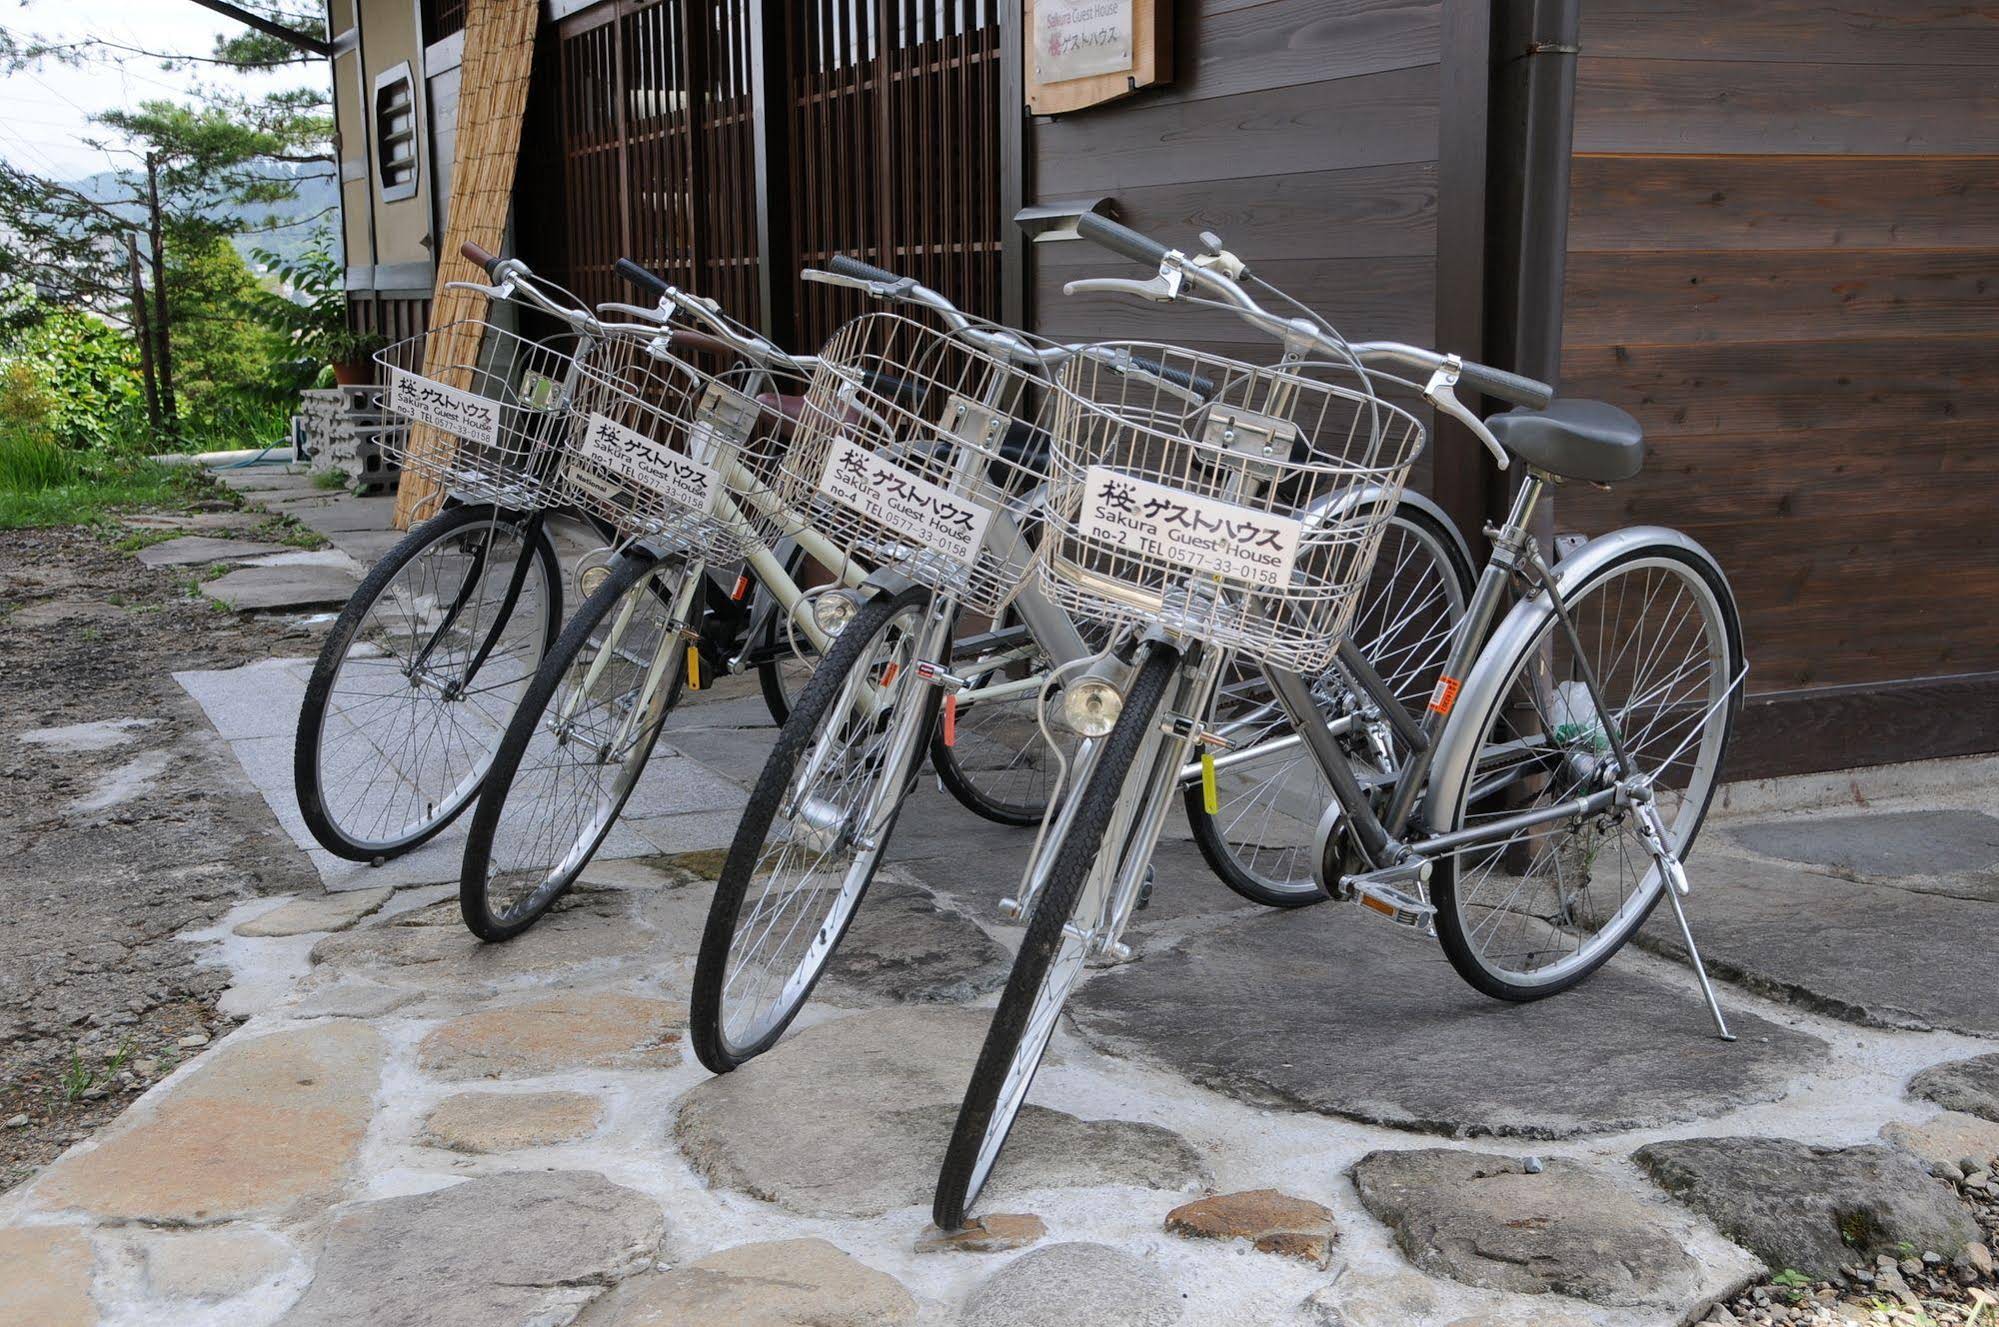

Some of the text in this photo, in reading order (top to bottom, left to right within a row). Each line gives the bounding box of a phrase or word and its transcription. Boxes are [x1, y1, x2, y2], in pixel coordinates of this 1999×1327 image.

[1073, 7, 1094, 24] Guest
[1094, 2, 1119, 18] House
[397, 405, 415, 417] no-3
[397, 393, 492, 432] Sakura Guest House
[398, 377, 492, 424] 桜 ゲストハウス
[591, 452, 613, 467] no-1
[593, 439, 707, 499] Sakura Guest House
[596, 423, 708, 488] 桜 ゲストハウス
[575, 473, 608, 493] National
[830, 484, 858, 504] no-4
[839, 449, 975, 531] 桜 ゲストハウス
[833, 468, 972, 544] Sakura Guest House
[1098, 479, 1284, 551] 桜 ゲストハウス
[1092, 526, 1128, 545] no-2
[1094, 506, 1282, 568] Sakura Guest House
